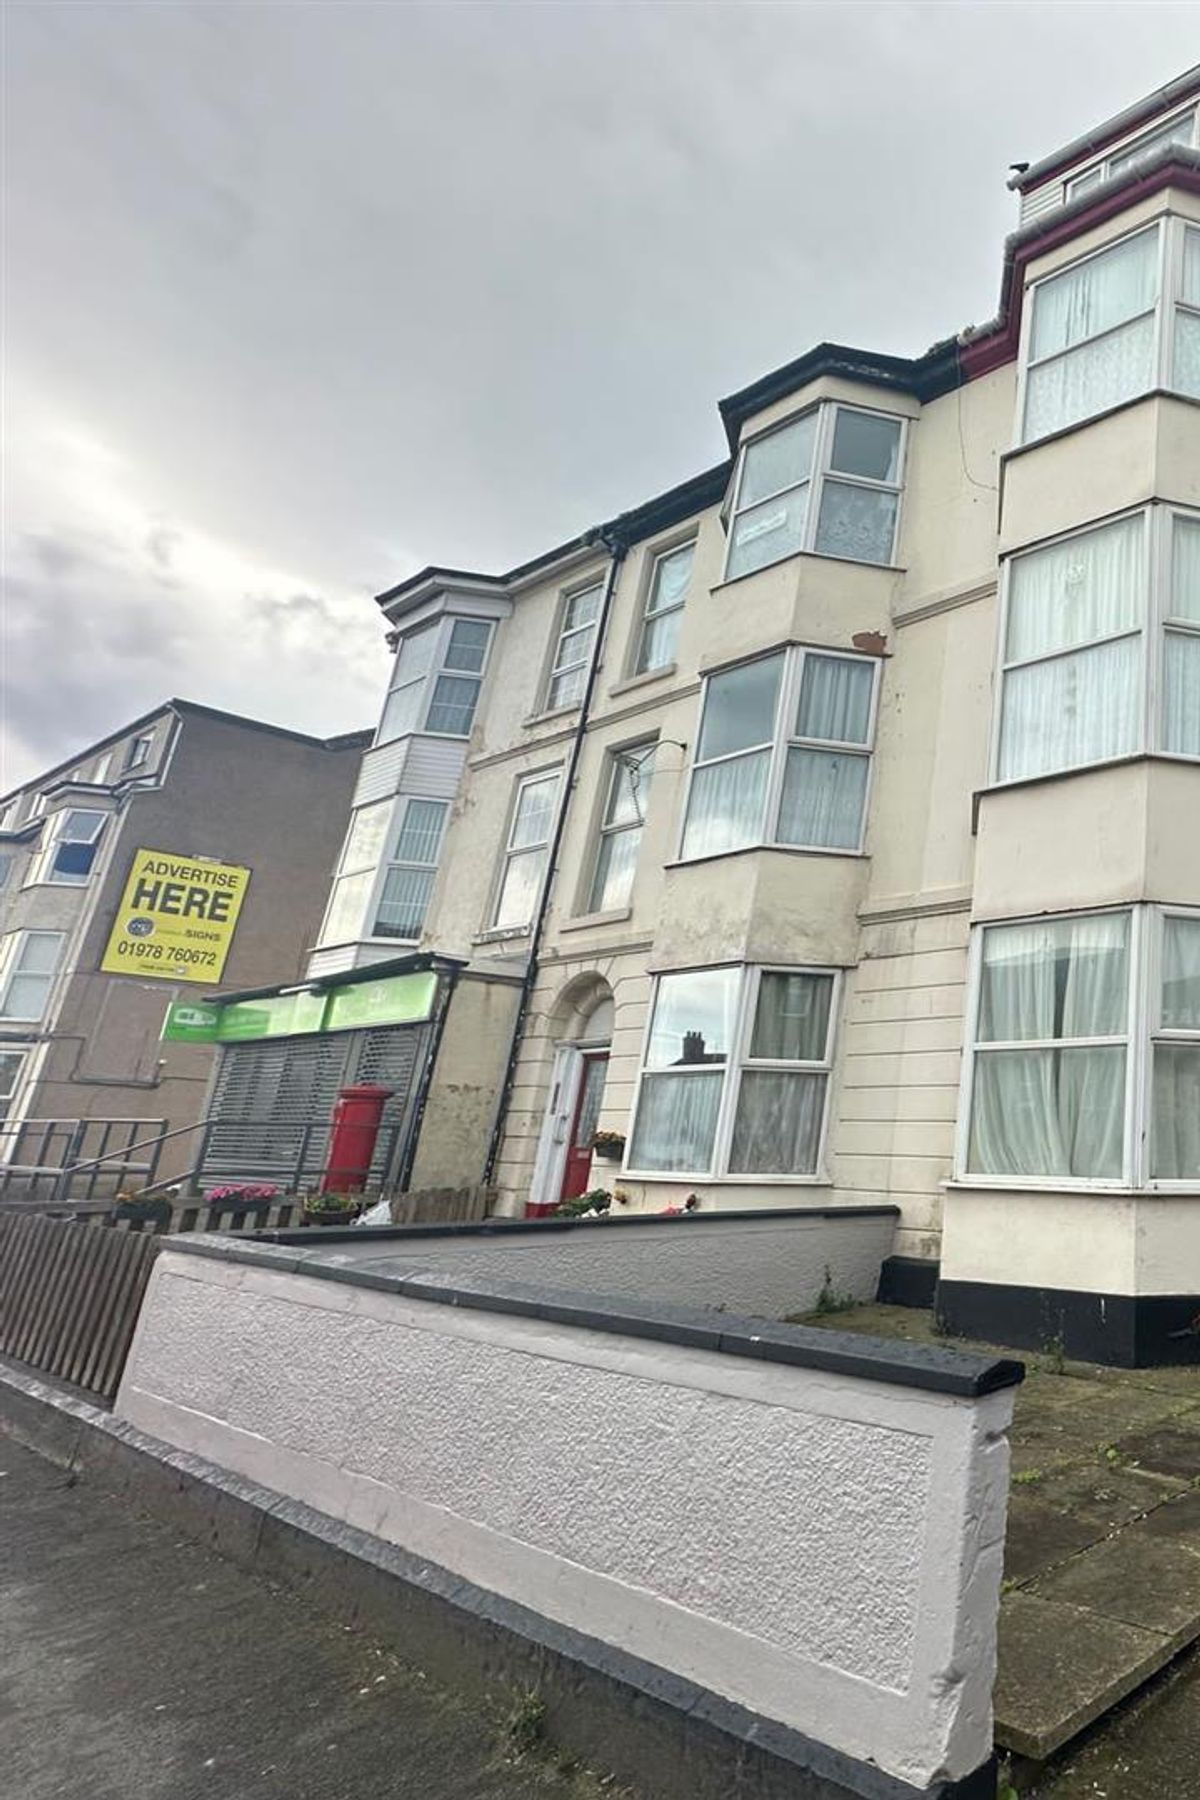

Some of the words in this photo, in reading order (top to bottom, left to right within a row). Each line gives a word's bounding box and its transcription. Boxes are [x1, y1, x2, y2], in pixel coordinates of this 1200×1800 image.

[142, 860, 239, 889] ADVERTISE
[130, 878, 234, 923] HERE
[185, 929, 222, 942] SIGNS
[118, 940, 163, 960] 01978
[166, 946, 217, 967] 760672
